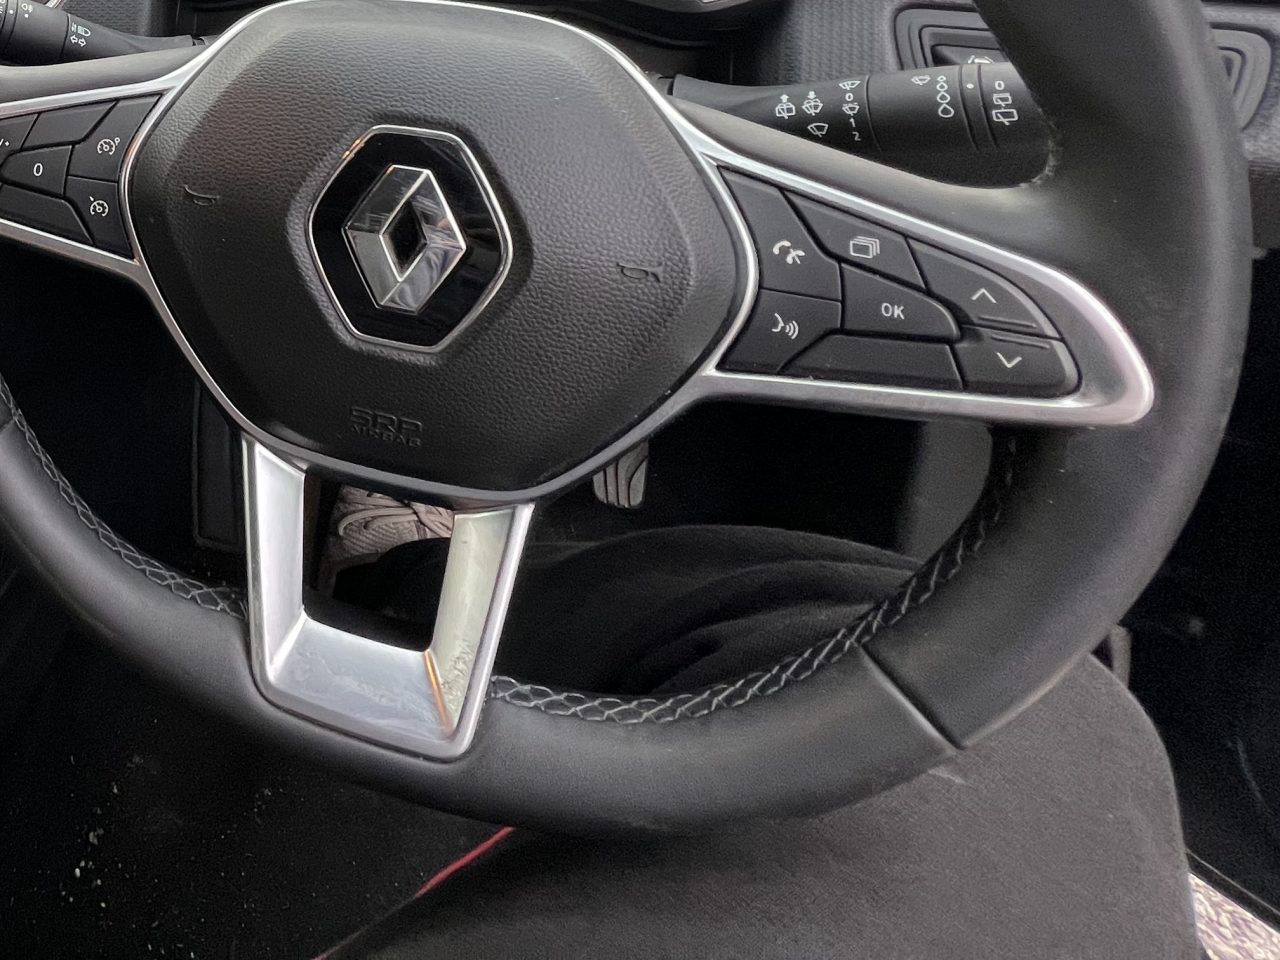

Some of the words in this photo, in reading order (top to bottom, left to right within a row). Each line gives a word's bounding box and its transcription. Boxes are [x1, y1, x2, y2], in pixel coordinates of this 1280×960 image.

[995, 80, 1005, 90] 0
[845, 92, 854, 101] 0
[850, 118, 856, 127] 1
[853, 131, 861, 141] 2
[33, 163, 43, 177] 0
[881, 302, 905, 320] OK
